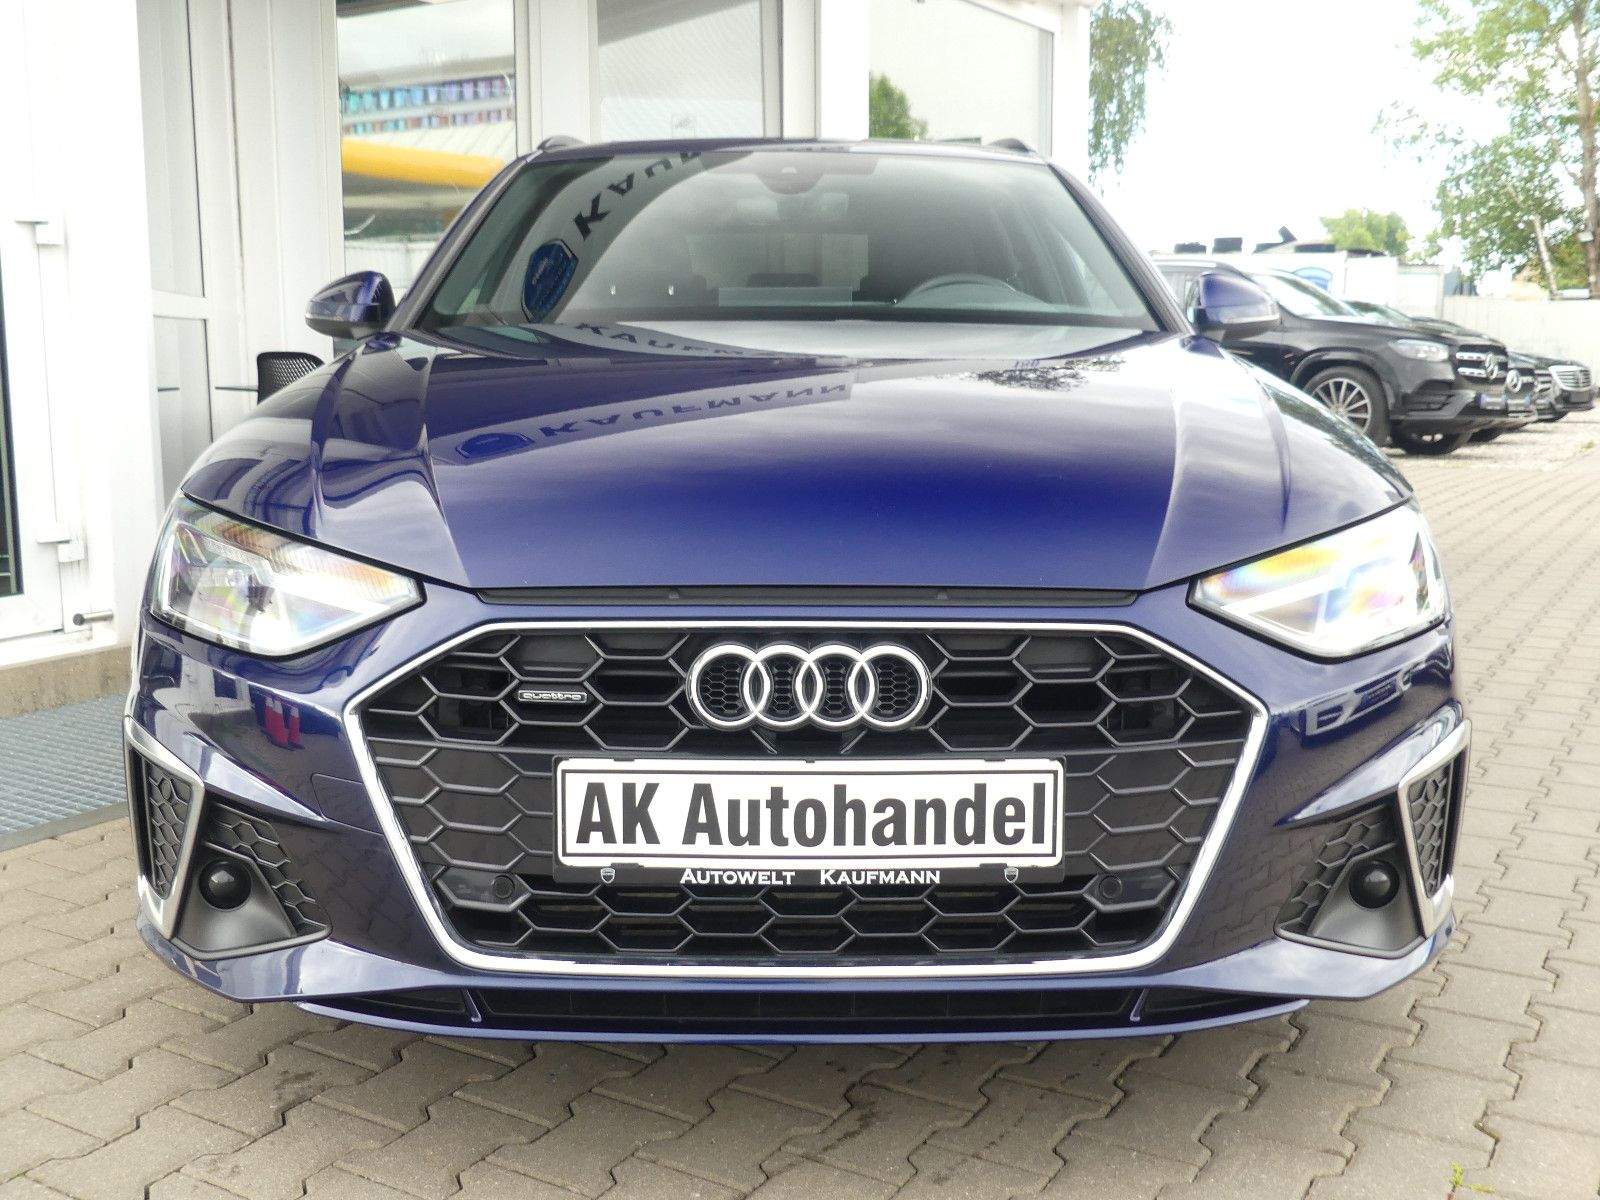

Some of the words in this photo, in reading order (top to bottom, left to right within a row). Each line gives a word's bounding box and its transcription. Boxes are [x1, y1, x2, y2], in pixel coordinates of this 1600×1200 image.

[522, 692, 582, 701] quattro
[576, 782, 660, 845] AK
[682, 782, 1046, 846] Autohandel
